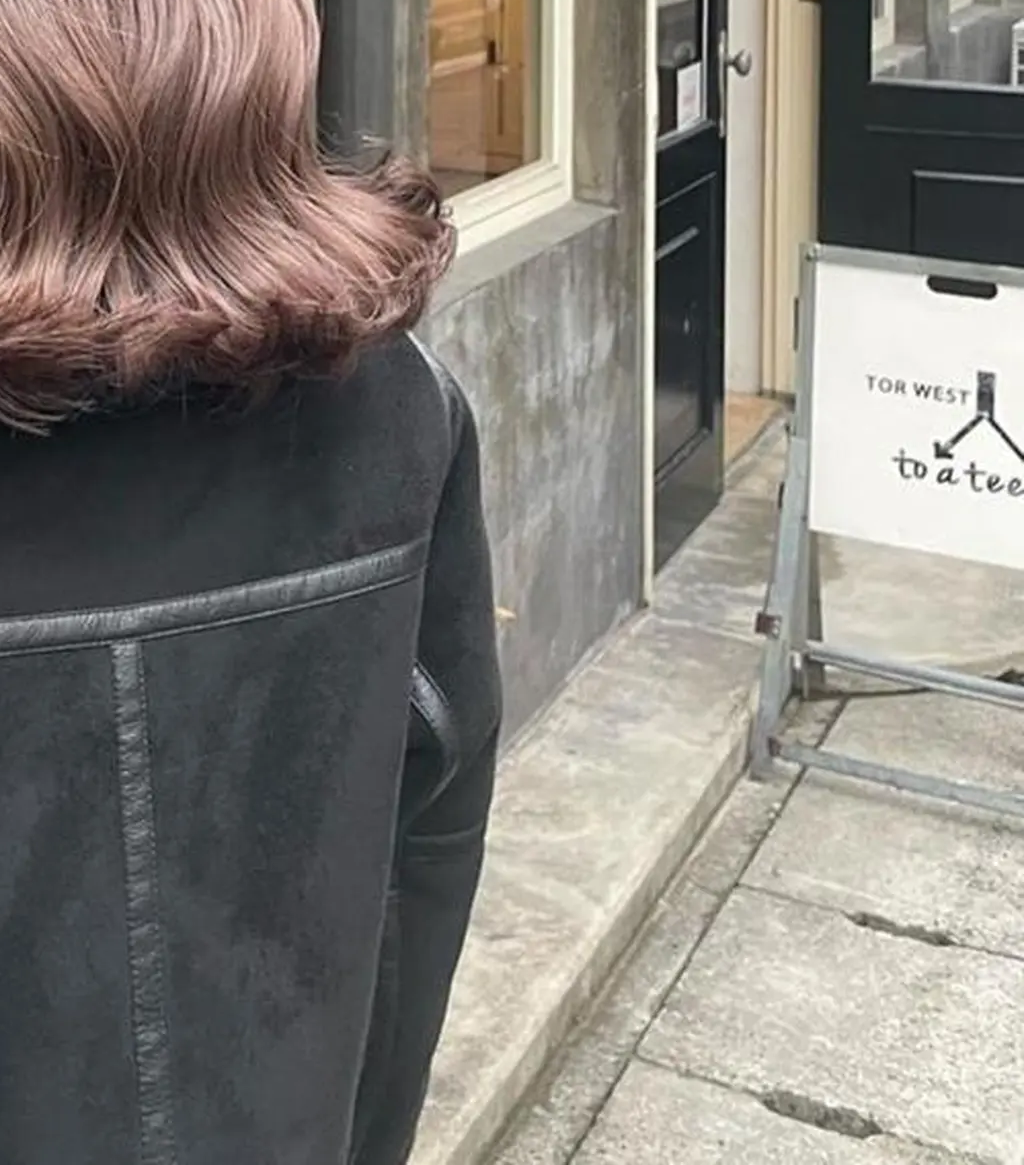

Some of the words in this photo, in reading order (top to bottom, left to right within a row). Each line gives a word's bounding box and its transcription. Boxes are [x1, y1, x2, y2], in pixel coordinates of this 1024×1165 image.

[866, 374, 907, 395] TOR
[913, 382, 971, 405] WEST
[892, 448, 928, 479] to
[936, 467, 960, 485] a
[964, 462, 1024, 496] tee
